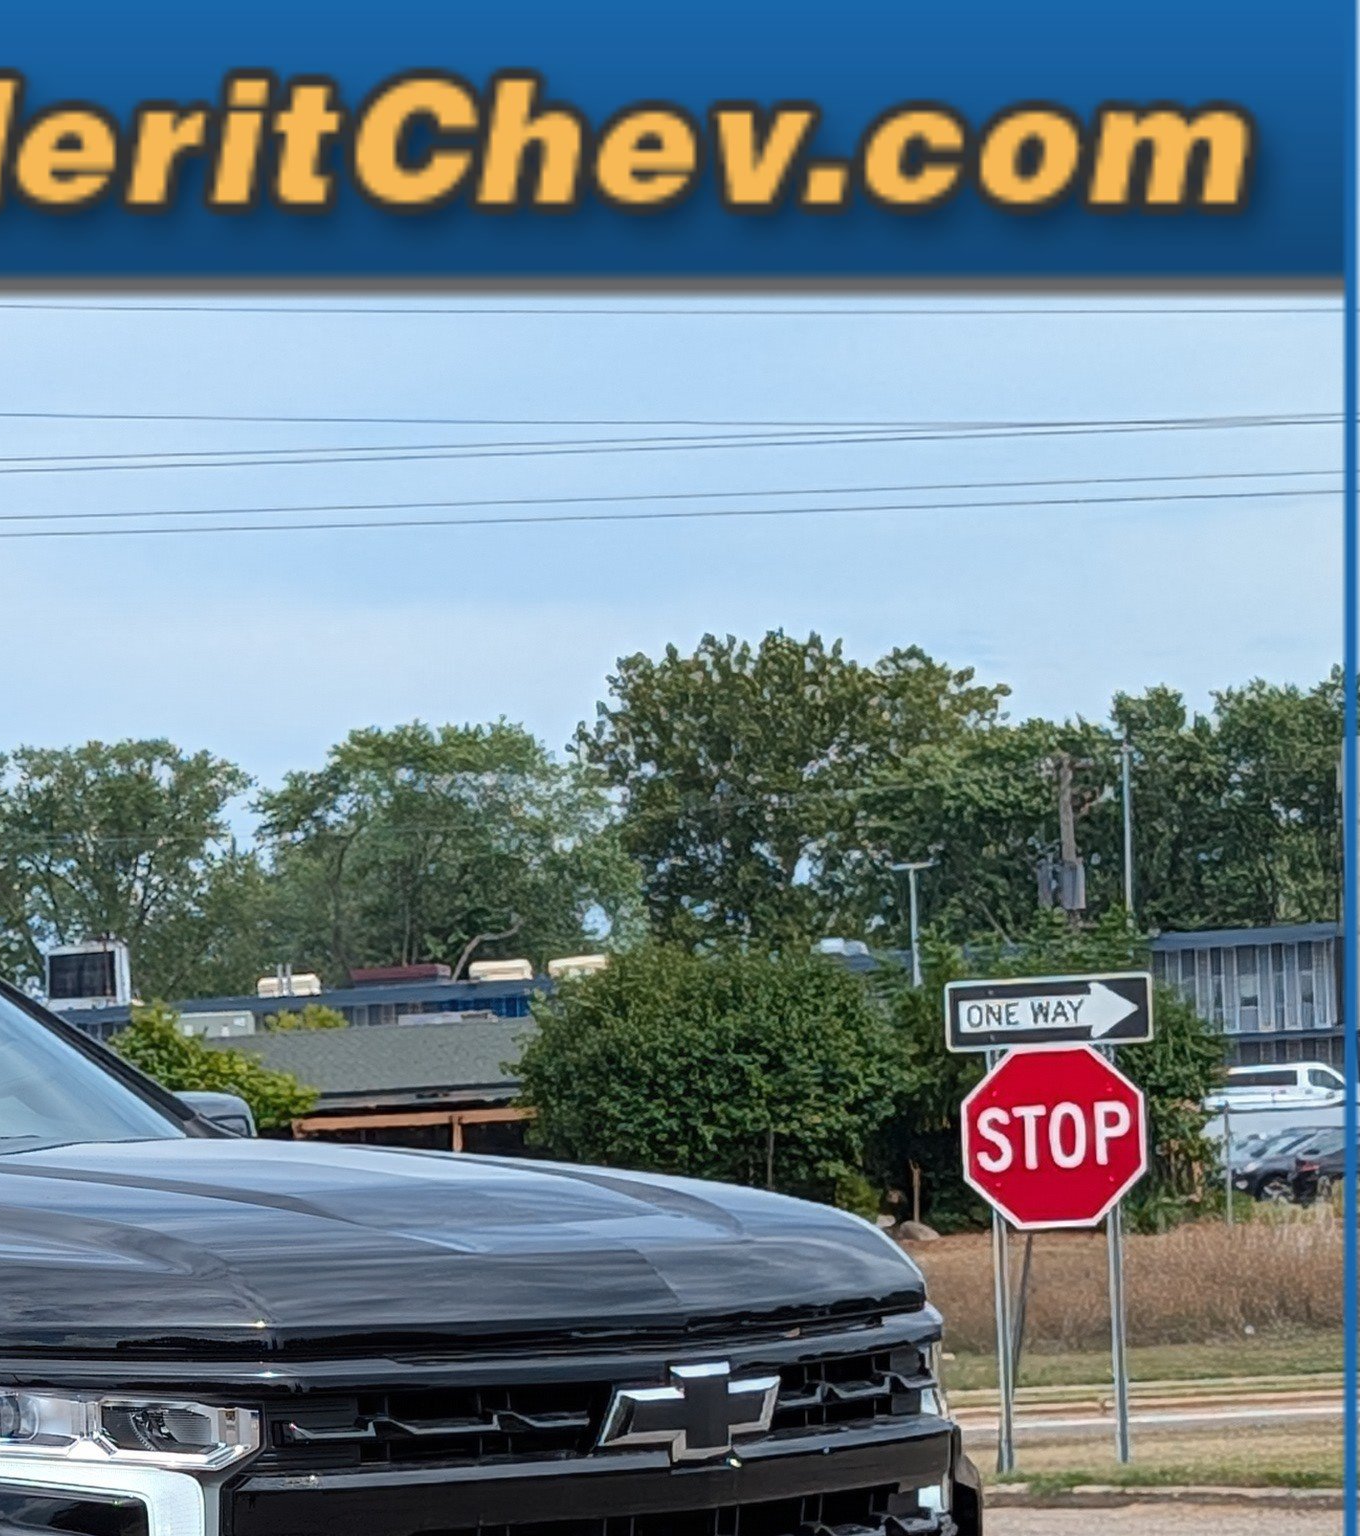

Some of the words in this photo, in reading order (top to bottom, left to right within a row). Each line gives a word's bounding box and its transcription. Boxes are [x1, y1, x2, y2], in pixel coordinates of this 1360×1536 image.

[965, 1002, 1020, 1028] ONE
[1030, 998, 1085, 1024] WAY
[976, 1100, 1131, 1174] STOP
